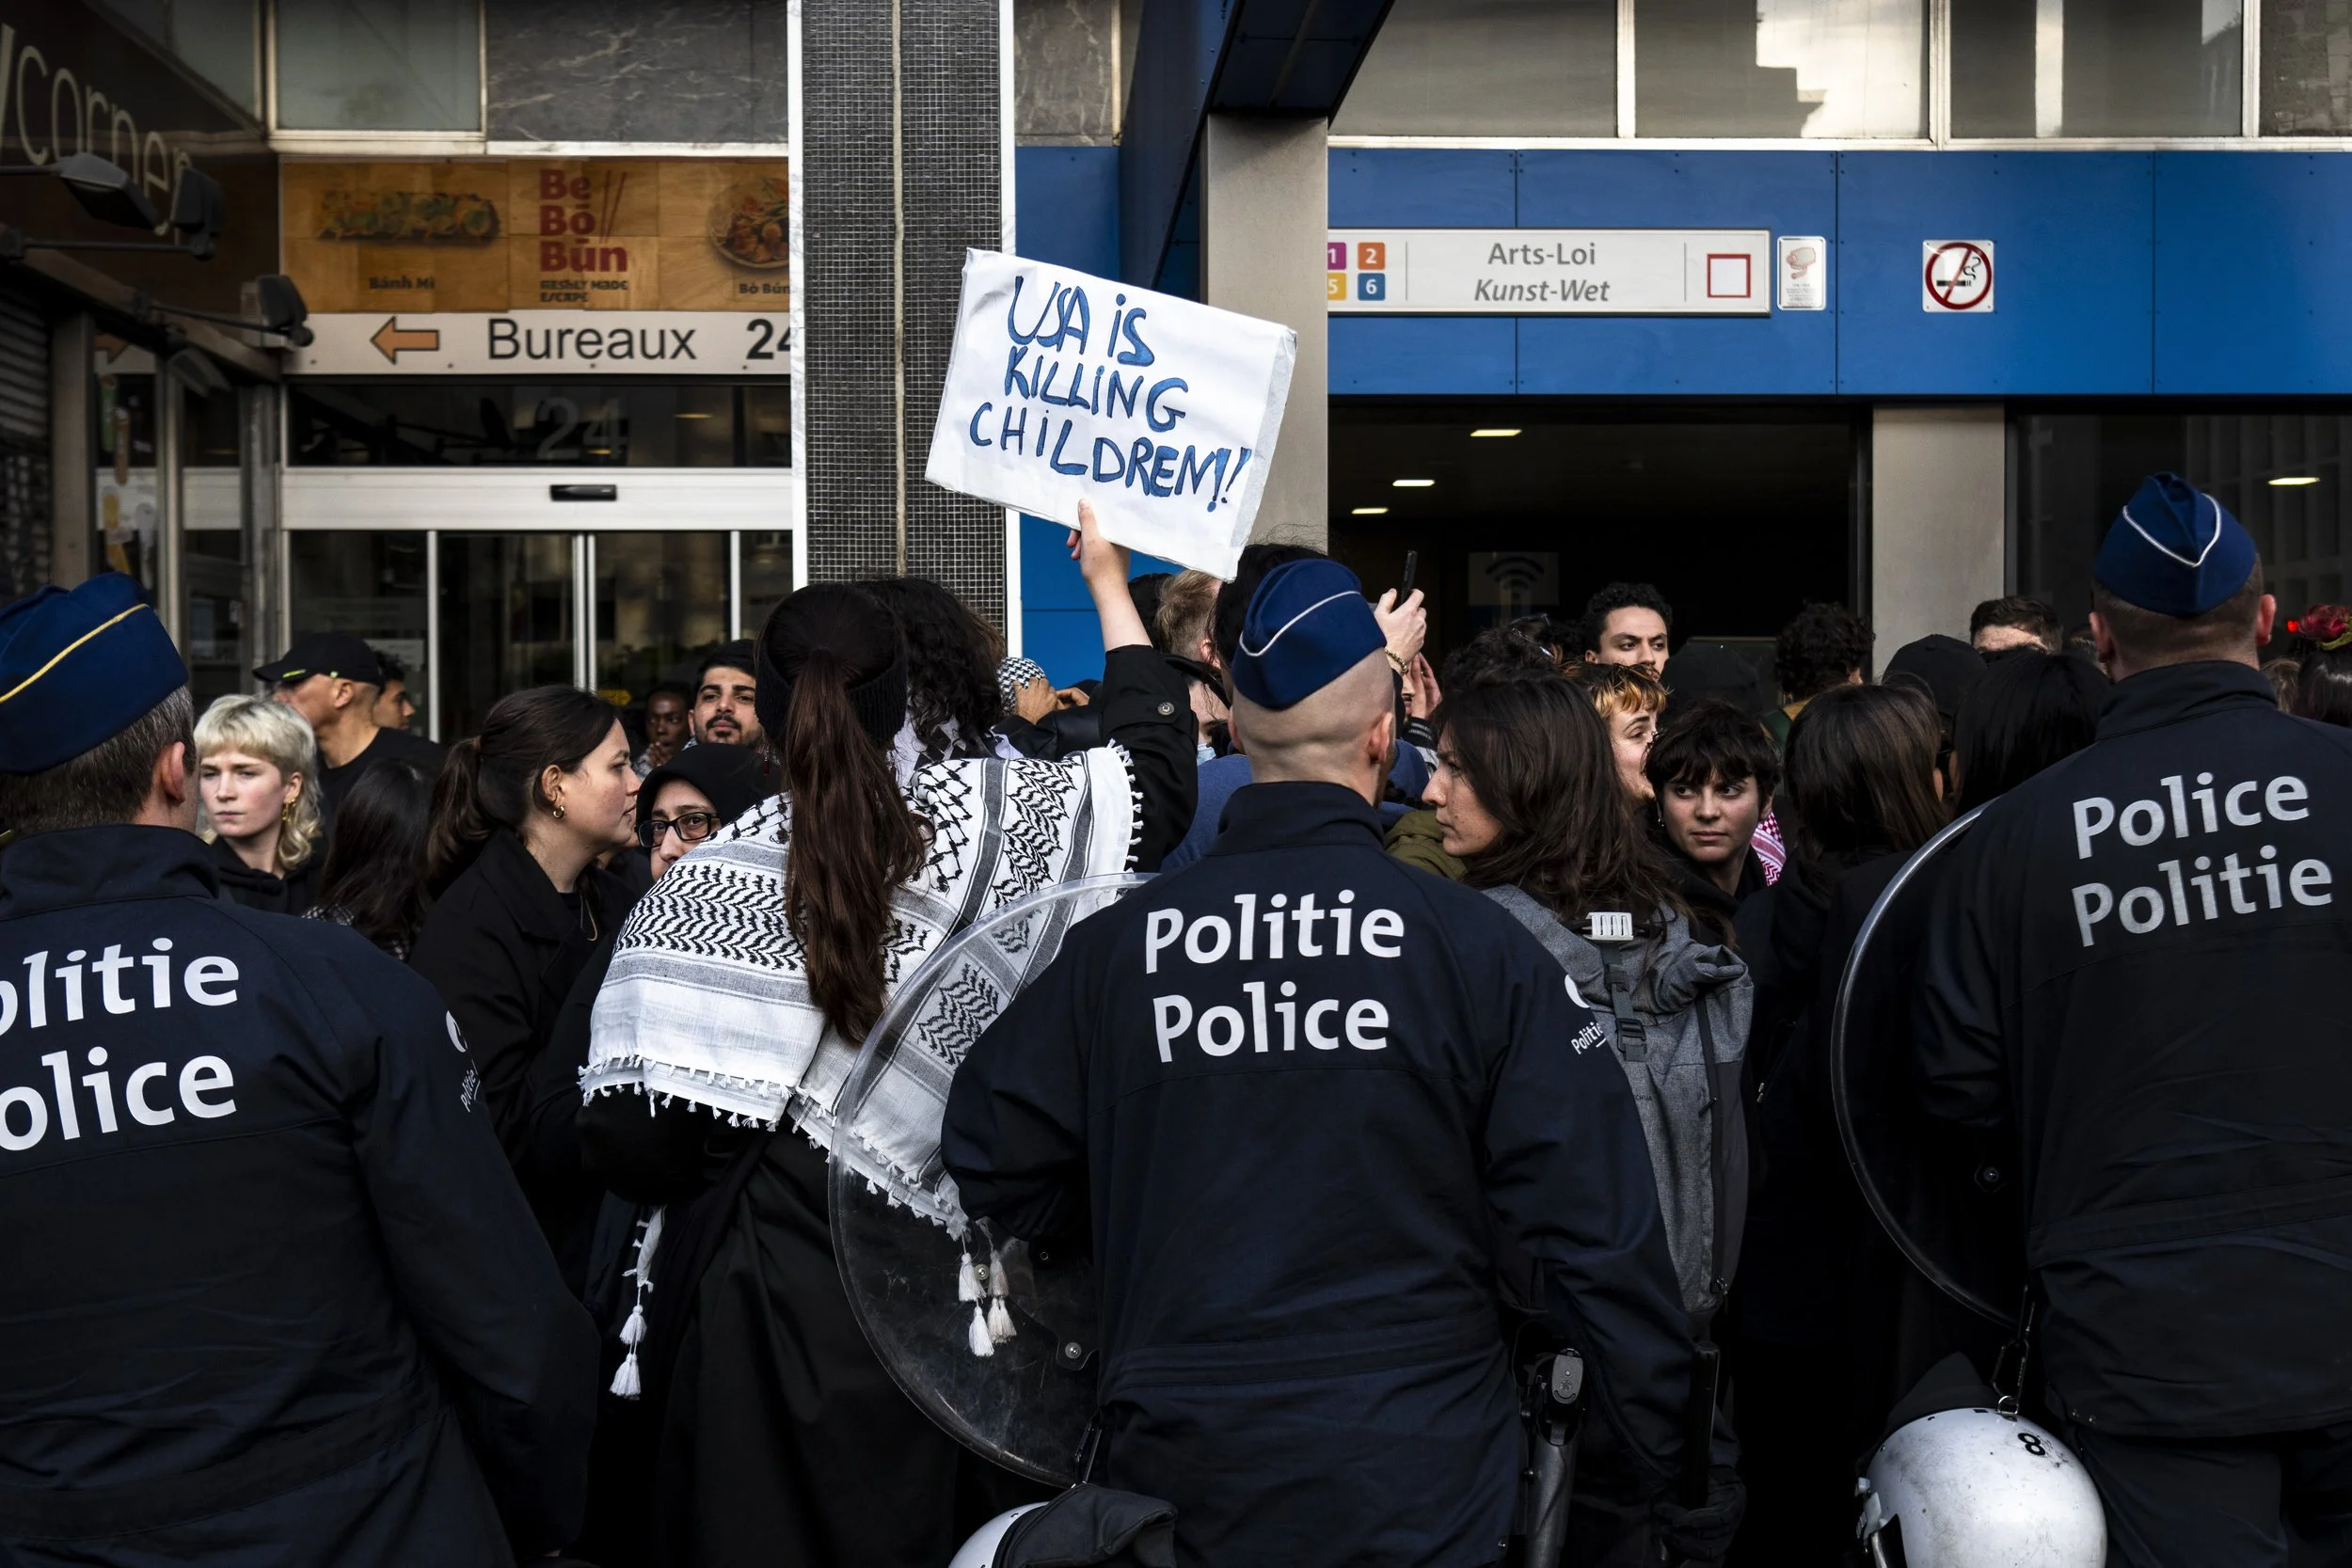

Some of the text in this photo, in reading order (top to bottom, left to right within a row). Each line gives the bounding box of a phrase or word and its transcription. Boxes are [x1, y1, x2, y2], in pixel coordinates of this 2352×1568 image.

[1327, 278, 1377, 294] 5 6
[1365, 248, 1377, 263] 2
[1487, 242, 1596, 265] Arts-Loi
[1008, 277, 1089, 355] USA
[1474, 279, 1610, 302] Kunst-Wet
[488, 318, 696, 359] Bureaux
[536, 397, 628, 461] 24
[2072, 771, 2310, 860] Police
[1145, 889, 1405, 974] Politie
[2072, 845, 2332, 947] Politie
[0, 937, 240, 1037] litie
[1152, 980, 1390, 1063] Police
[0, 1046, 237, 1151] olice
[2017, 1433, 2045, 1456] 8
